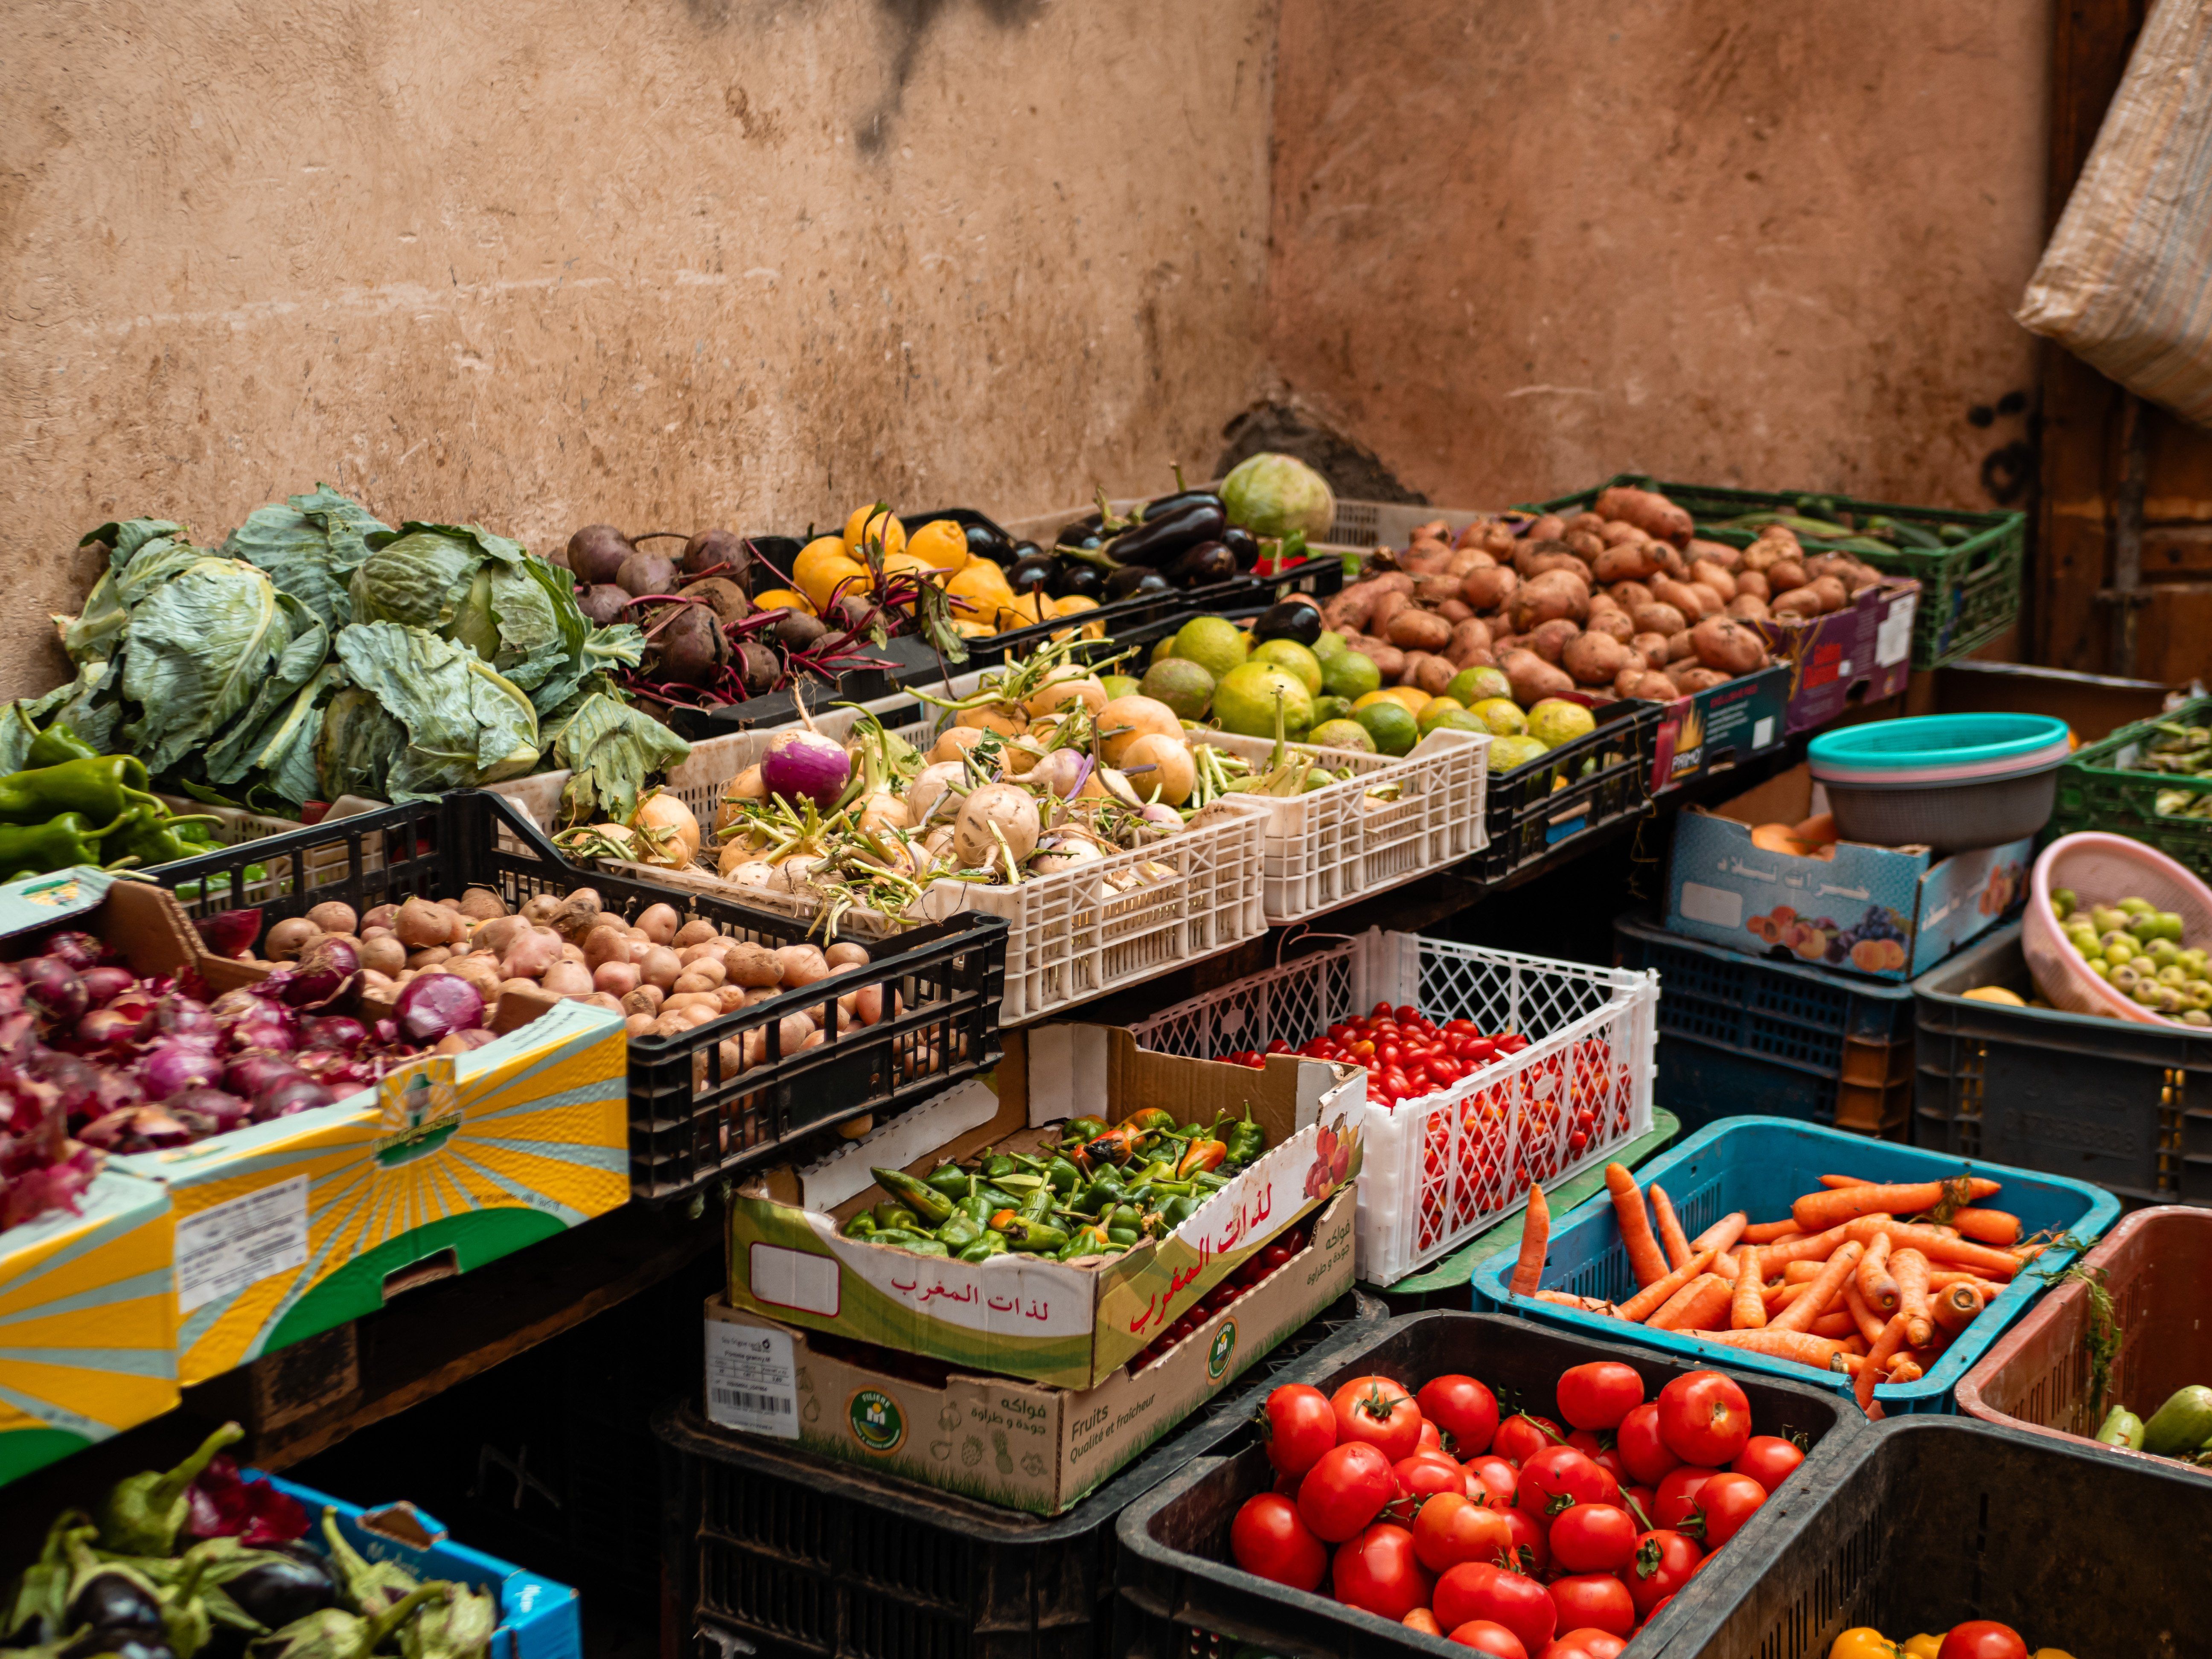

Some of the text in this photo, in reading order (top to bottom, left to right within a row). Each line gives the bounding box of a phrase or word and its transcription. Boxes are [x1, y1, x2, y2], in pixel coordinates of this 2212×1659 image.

[1326, 1219, 1350, 1250] فواكه
[1130, 1182, 1272, 1335] لذات المغرب
[891, 1278, 1048, 1321] لذات المغرب
[1001, 1398, 1046, 1420] فواكه
[1070, 1393, 1155, 1464] Qualité et fraîcheur
[1071, 1404, 1109, 1443] Fruits
